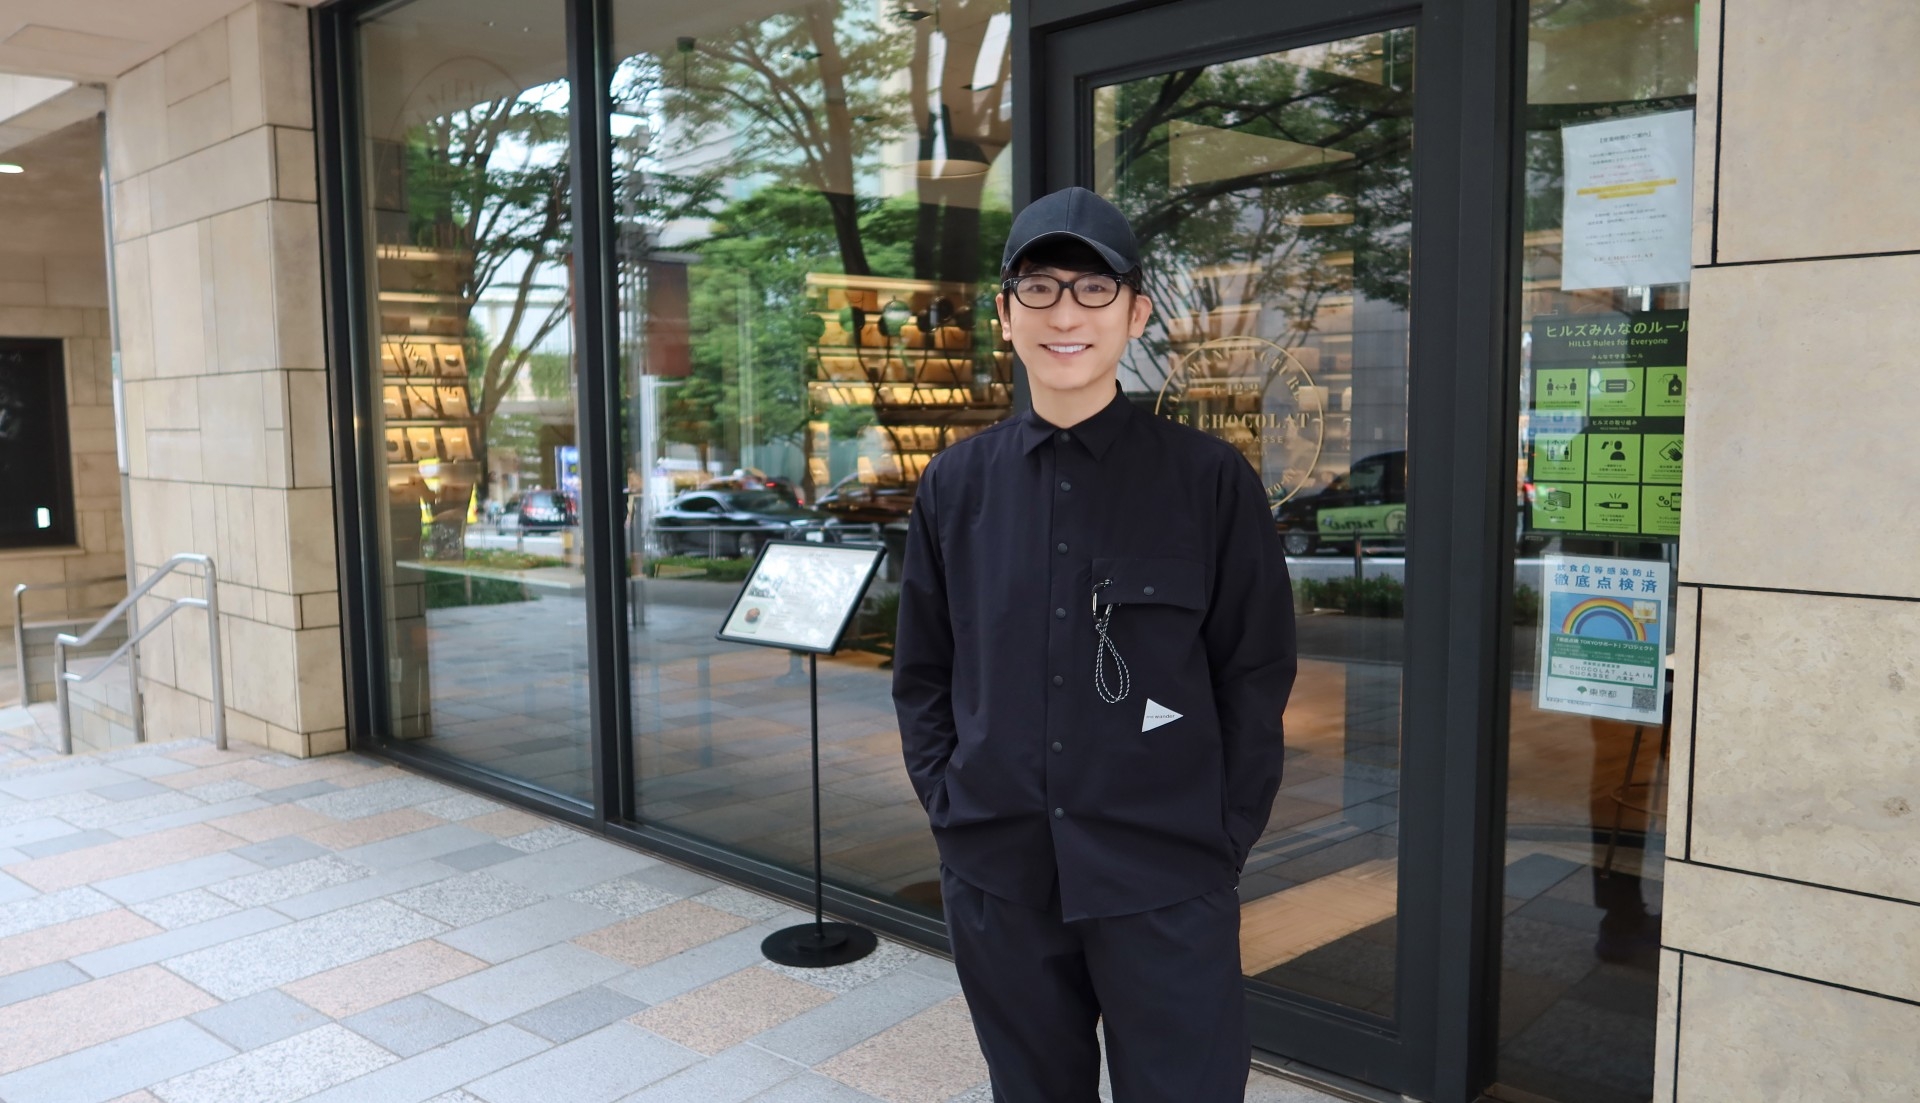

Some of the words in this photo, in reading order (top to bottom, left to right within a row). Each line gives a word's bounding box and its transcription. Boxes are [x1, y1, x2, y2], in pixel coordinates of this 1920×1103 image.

[1593, 339, 1615, 347] Rules
[1616, 338, 1629, 346] for
[1630, 338, 1668, 347] Everyone
[1198, 413, 1310, 429] CHOCOLAT
[1228, 435, 1284, 444] DUCASSE
[1554, 573, 1657, 594] 徹底点検済
[1569, 664, 1616, 674] CHOCOLAT
[1623, 671, 1653, 679] ALAIN
[1569, 671, 1610, 679] DUCASSE
[1589, 688, 1617, 698] 東京都
